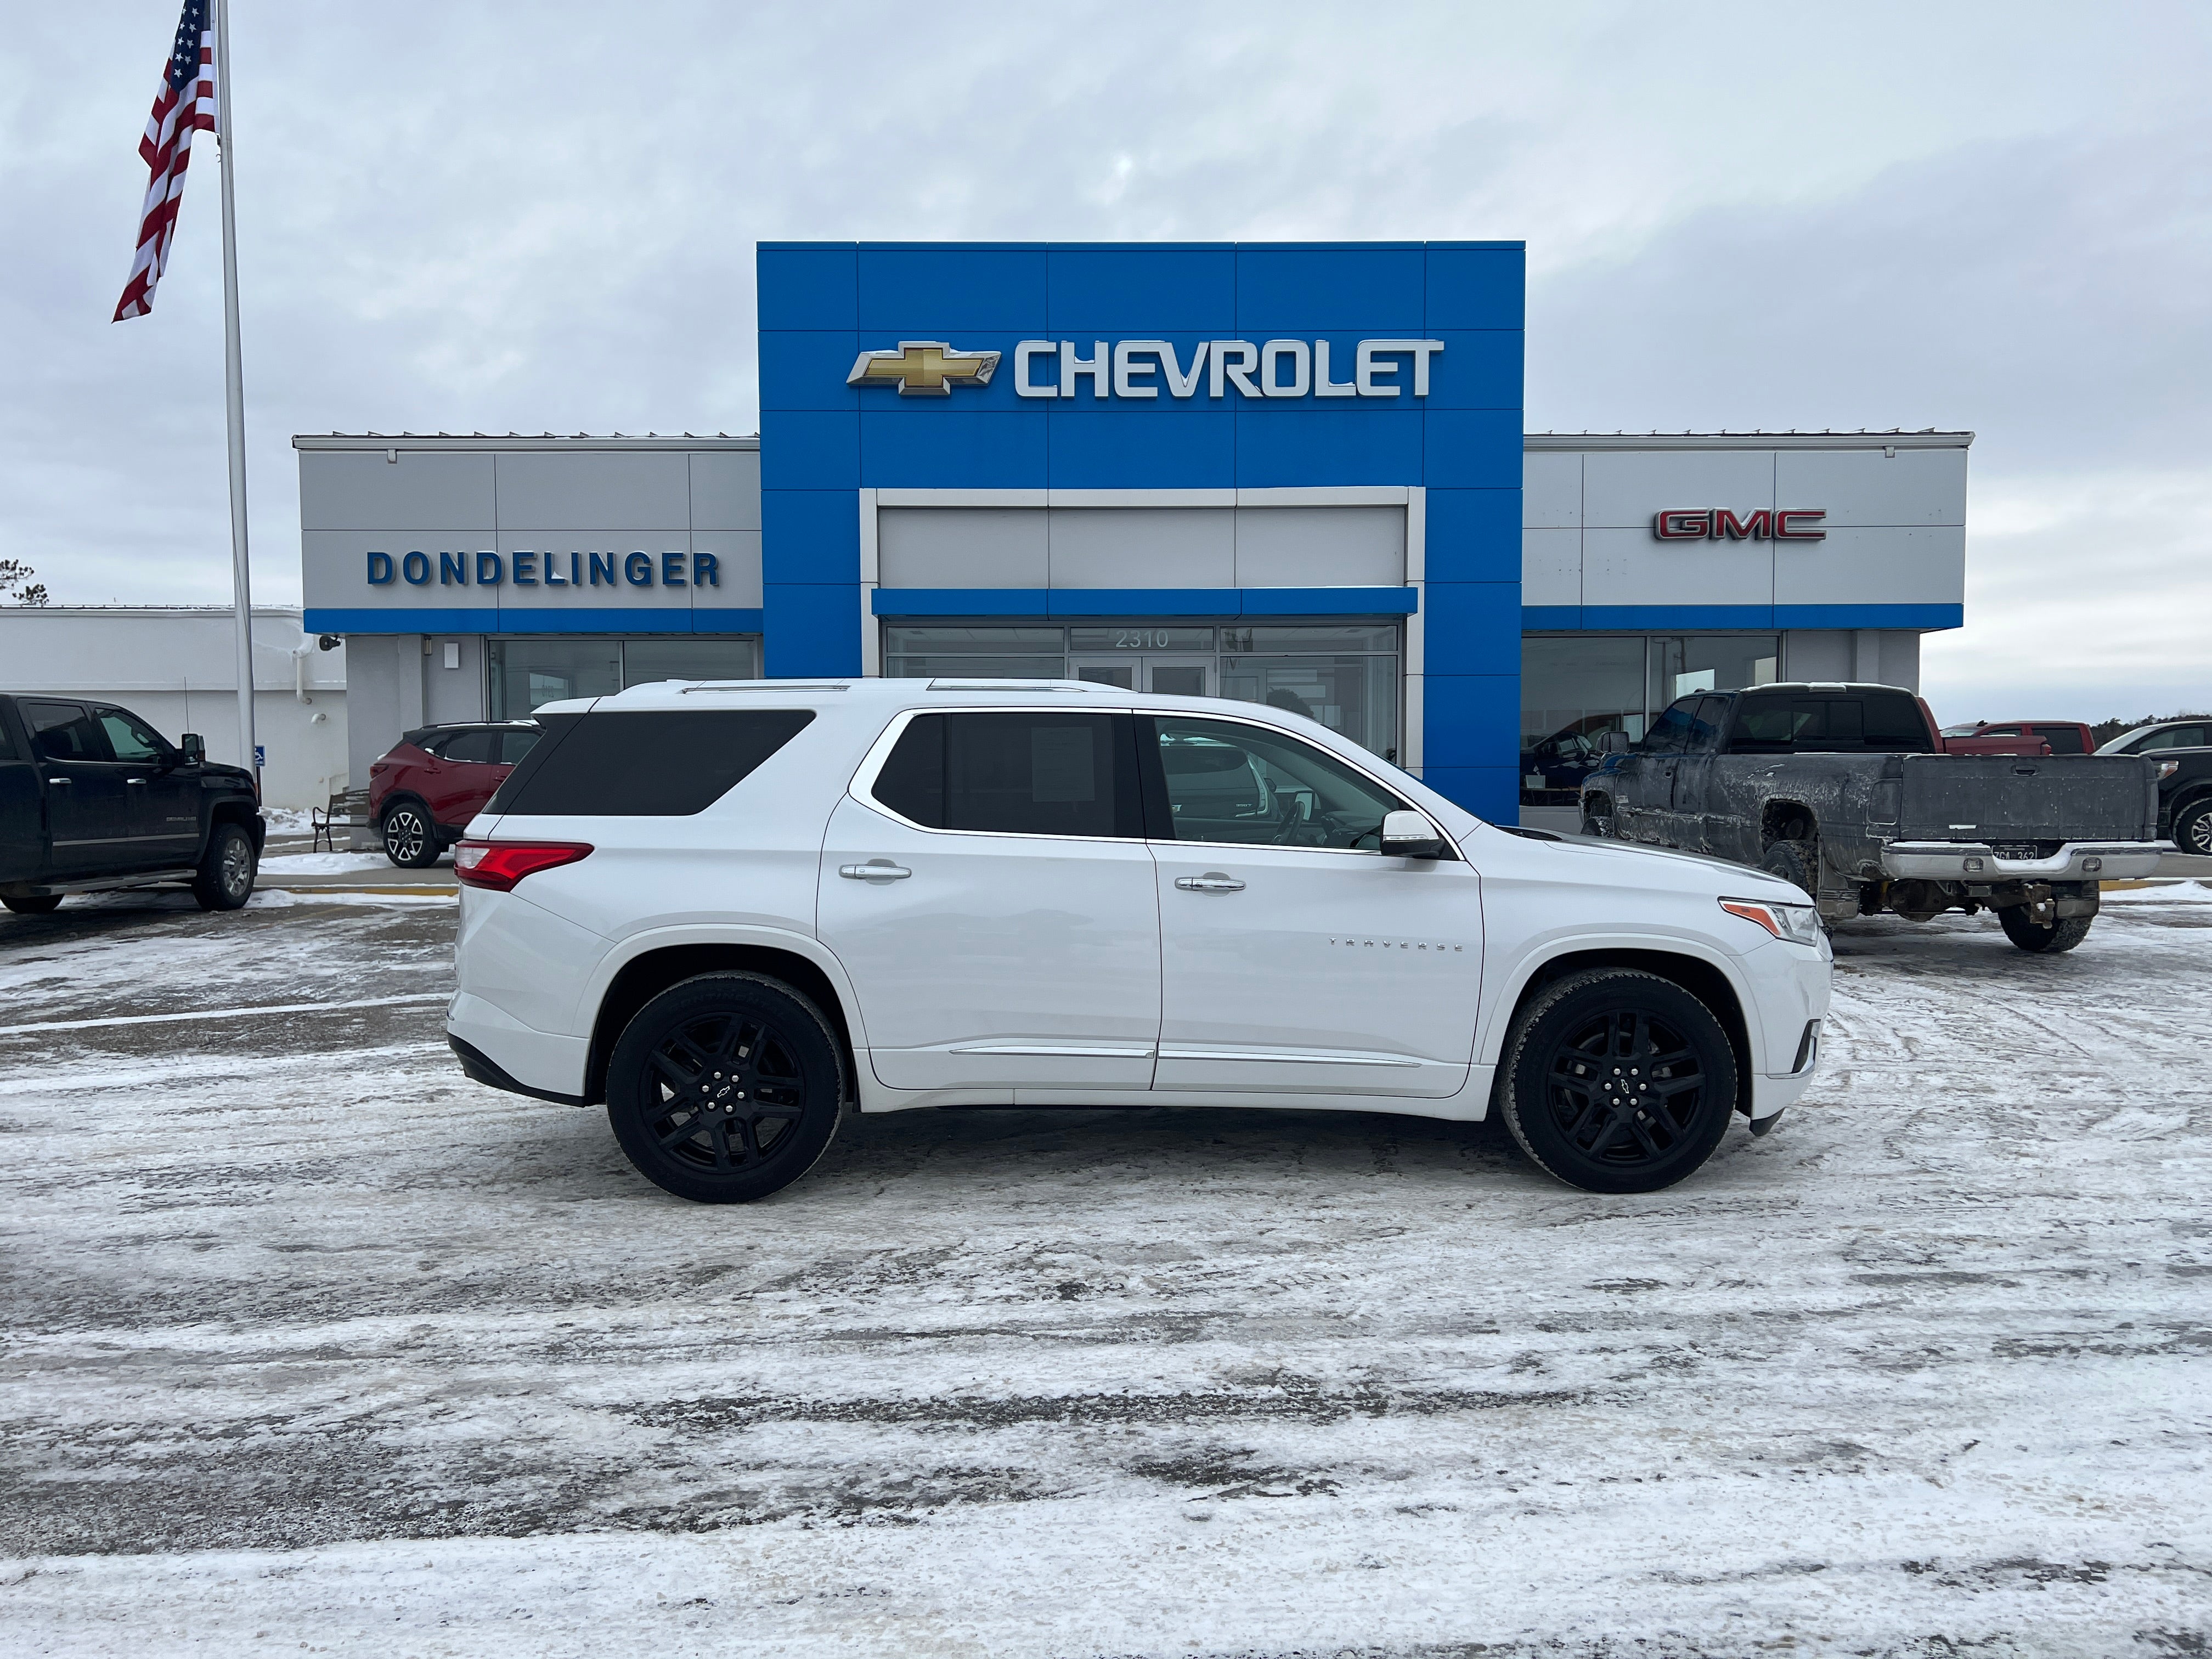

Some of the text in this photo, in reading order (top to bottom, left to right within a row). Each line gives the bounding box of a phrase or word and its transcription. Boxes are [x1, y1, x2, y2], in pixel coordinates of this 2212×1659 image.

[1014, 340, 1444, 398] CHEVROLET
[1654, 507, 1827, 540] GMC
[366, 550, 719, 586] DONDELINGER
[1115, 630, 1169, 648] 2310
[1329, 937, 1463, 951] TRAVERSE
